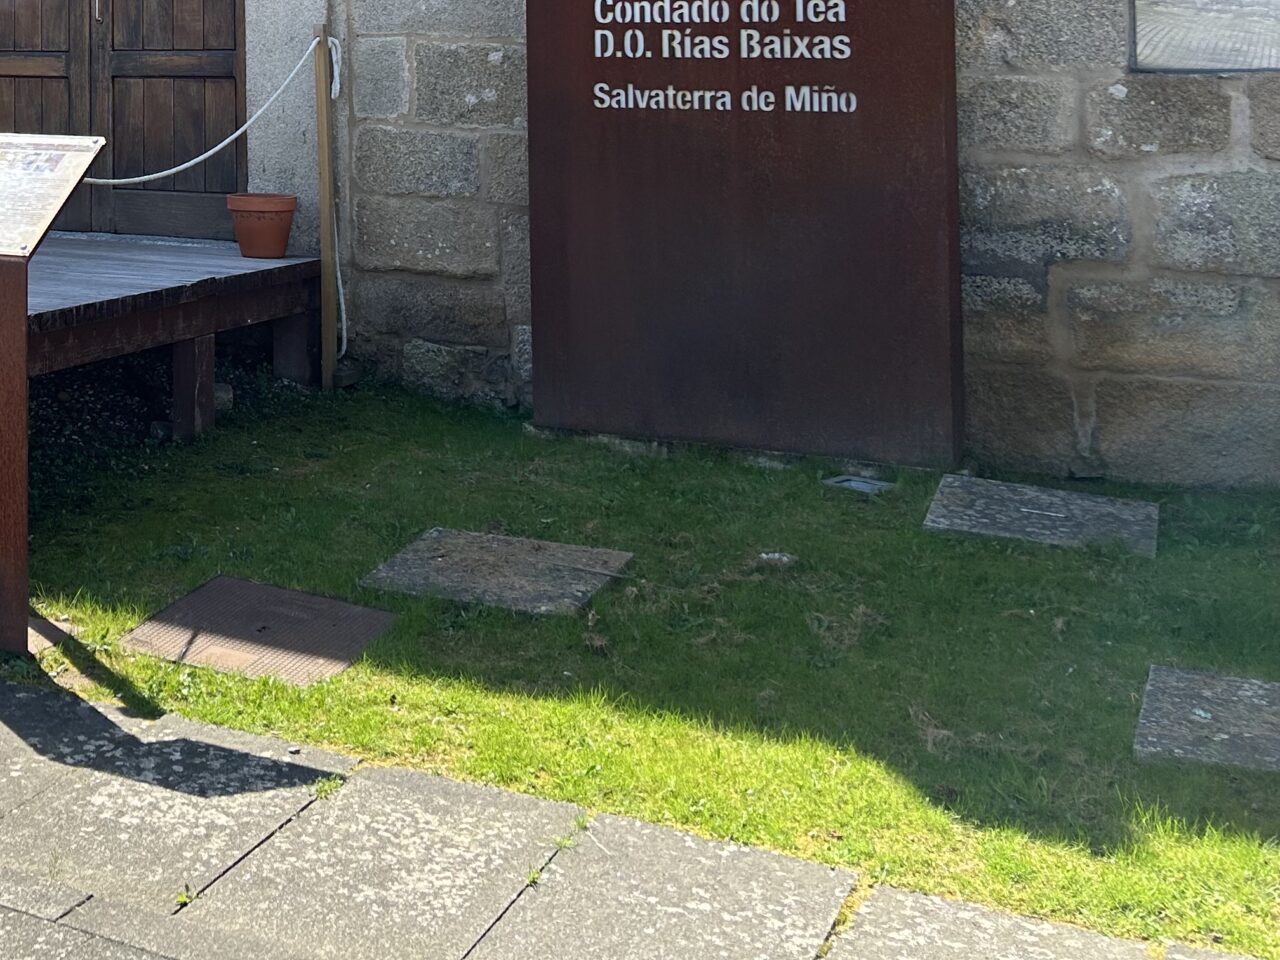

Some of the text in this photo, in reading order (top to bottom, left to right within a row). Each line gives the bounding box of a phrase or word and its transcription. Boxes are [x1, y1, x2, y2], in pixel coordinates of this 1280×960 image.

[594, 28, 851, 59] D.O. Rías Baixas
[593, 82, 857, 113] Salvaterra de Miño
